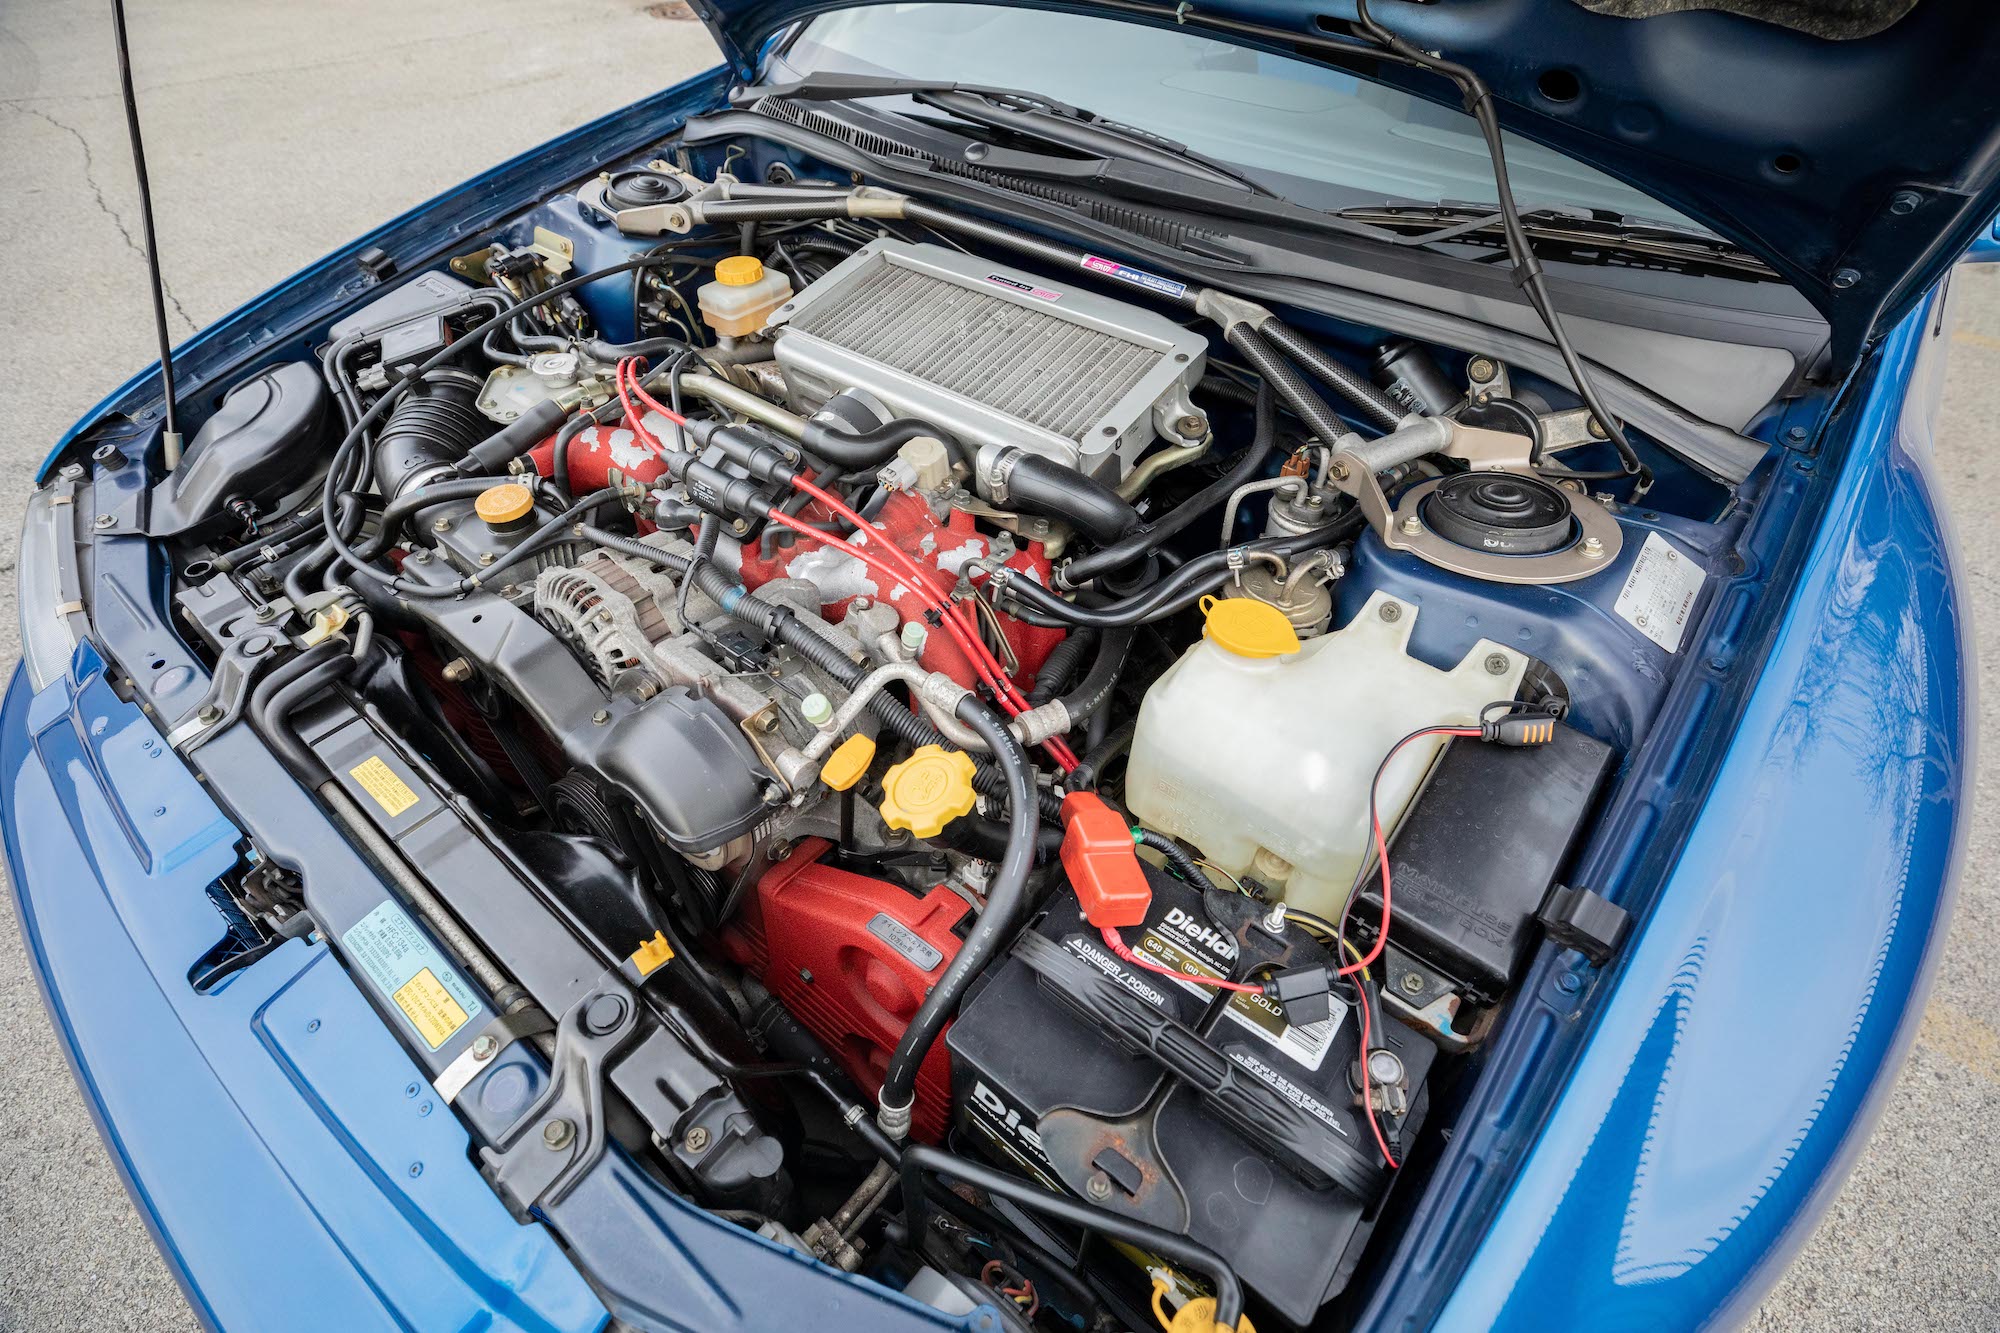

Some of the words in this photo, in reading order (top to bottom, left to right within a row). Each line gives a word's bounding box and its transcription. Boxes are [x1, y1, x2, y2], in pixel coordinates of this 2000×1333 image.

[385, 924, 409, 953] HFC-134a
[1147, 939, 1162, 952] 640
[1157, 926, 1175, 939] Advance
[1174, 936, 1185, 945] Auto
[1164, 907, 1236, 961] DieHar
[1458, 917, 1504, 948] BOX
[1082, 943, 1121, 975] DANGER
[1120, 972, 1129, 983] /
[1127, 975, 1165, 1007] POISON
[1185, 963, 1199, 975] 100
[452, 982, 466, 998] SUBARU
[467, 1000, 477, 1011] TJ
[1250, 993, 1283, 1017] GOLD
[1244, 1059, 1254, 1068] NOT
[1263, 1073, 1275, 1082] KEEP
[1276, 1081, 1288, 1091] VENT
[1287, 1089, 1300, 1100] CAPS
[1301, 1098, 1315, 1109] TIGHT
[1315, 1109, 1326, 1118] AND
[1247, 1056, 1260, 1065] KEEP
[1259, 1064, 1270, 1073] OUT
[1277, 1075, 1287, 1085] THE
[1287, 1083, 1303, 1096] REACH
[1310, 1099, 1333, 1117] CHILDREN
